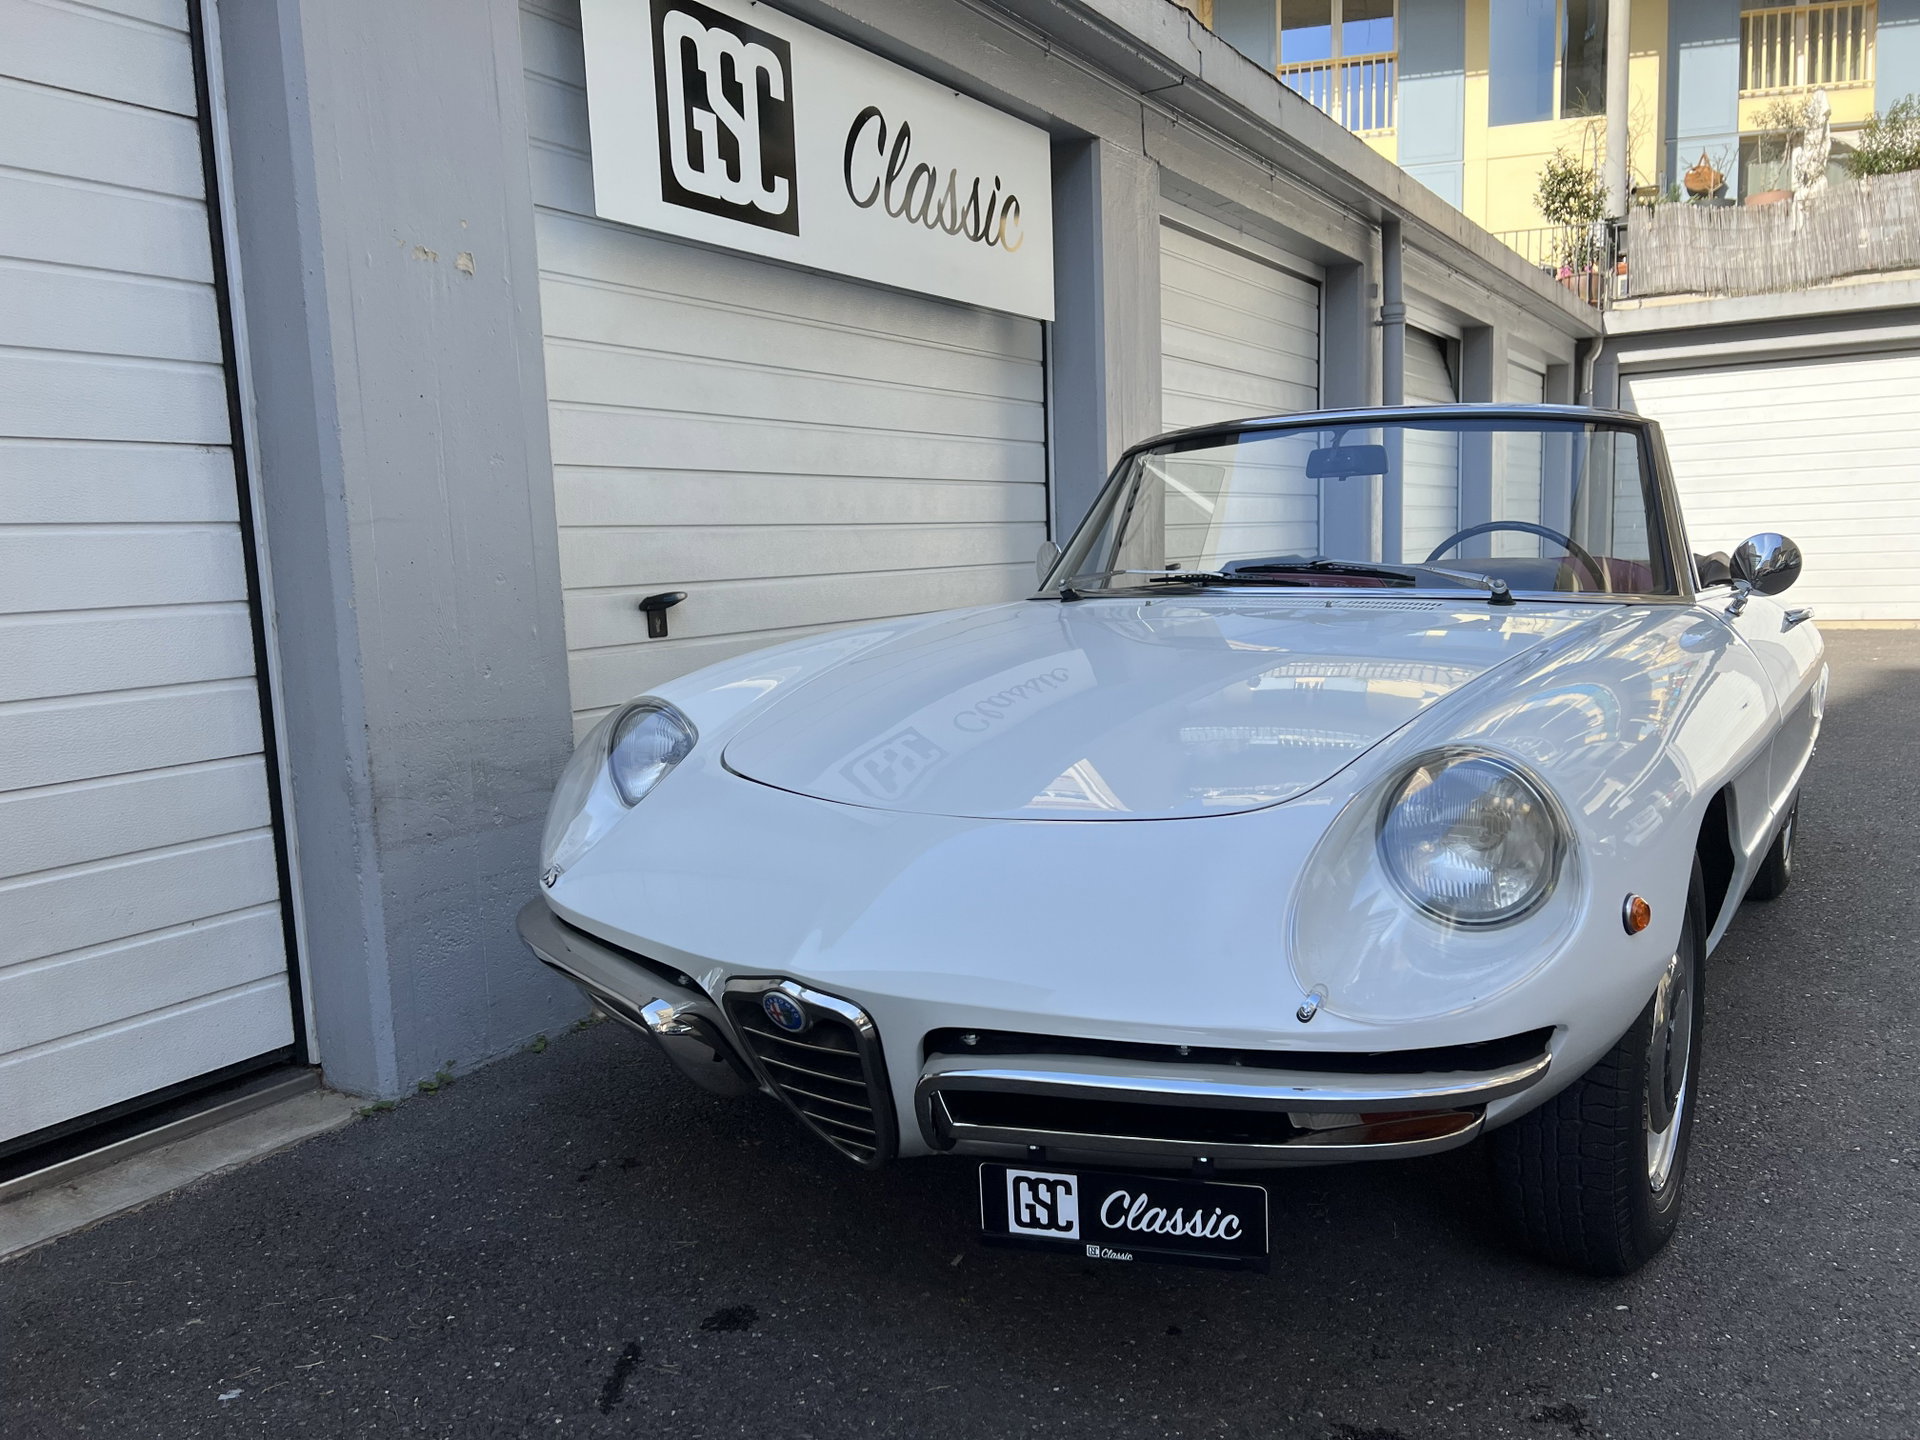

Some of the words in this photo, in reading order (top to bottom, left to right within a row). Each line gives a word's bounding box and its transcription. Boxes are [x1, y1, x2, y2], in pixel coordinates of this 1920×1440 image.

[663, 9, 789, 215] GSC
[843, 105, 1024, 253] Classic
[1012, 1175, 1074, 1232] GSC
[1100, 1190, 1242, 1240] Classic
[1101, 1248, 1133, 1261] Classic
